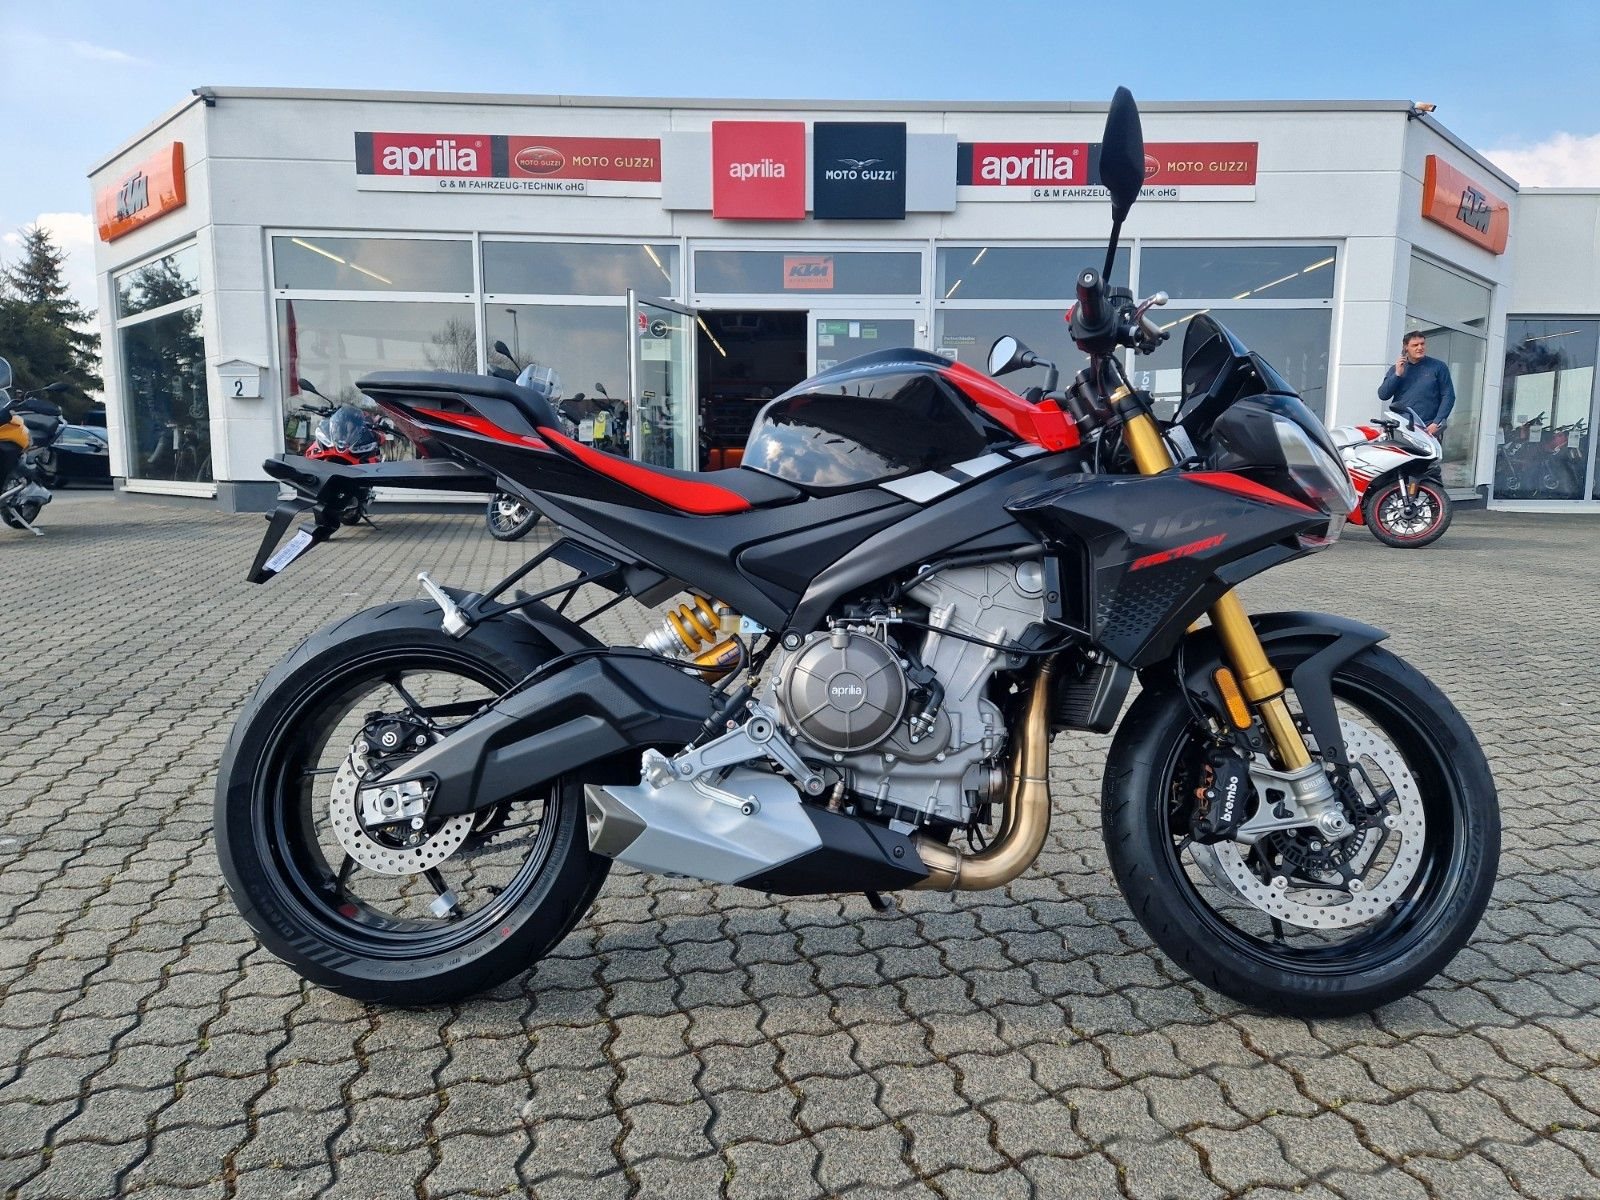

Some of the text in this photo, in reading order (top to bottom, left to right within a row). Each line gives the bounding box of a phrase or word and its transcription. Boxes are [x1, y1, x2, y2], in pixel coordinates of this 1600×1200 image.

[382, 139, 478, 176] aprilia
[519, 159, 561, 167] MOTO GUZZI
[572, 156, 654, 168] MOTO GUZZI
[729, 158, 785, 182] aprilia
[981, 148, 1074, 186] aprilia
[1167, 161, 1248, 172] MOTO GUZZI
[825, 169, 895, 181] MOTO GUZZI
[439, 179, 585, 191] G & M FAHRZEUG-TECHNIK oHG
[1033, 189, 1041, 197] G
[1043, 189, 1050, 197] &
[1052, 189, 1060, 197] M
[1157, 188, 1177, 197] oHG
[116, 171, 149, 220] KTM
[1456, 185, 1492, 235] KTM
[234, 379, 244, 397] 2
[831, 684, 862, 698] aprilia
[1220, 775, 1239, 822] brembo
